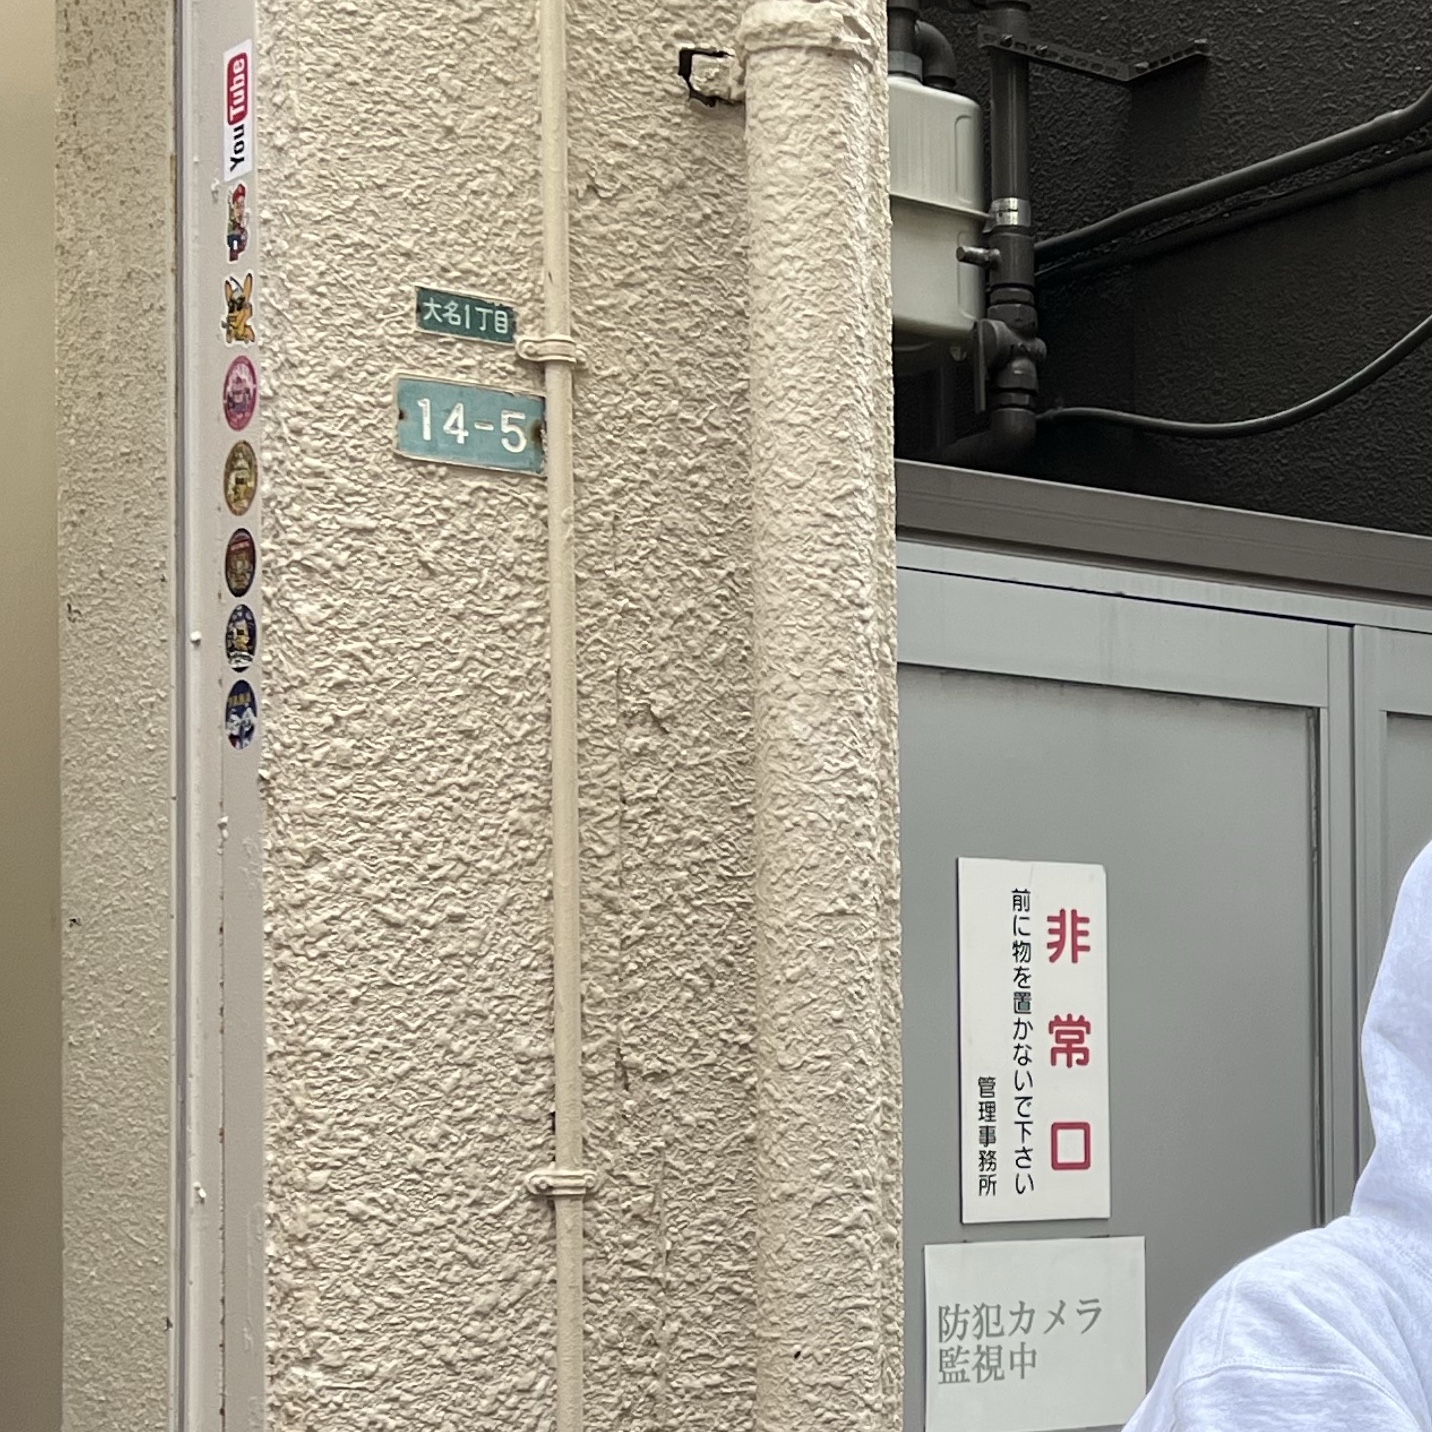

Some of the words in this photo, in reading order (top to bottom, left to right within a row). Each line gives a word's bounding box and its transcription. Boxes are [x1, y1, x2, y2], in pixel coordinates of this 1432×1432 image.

[228, 57, 247, 173] YouTube
[417, 398, 527, 453] 14-5
[1011, 888, 1035, 1196] 前に物を置かないで下さい
[1047, 908, 1092, 1171] 非常口
[977, 1076, 998, 1197] 管理事務所
[937, 1342, 1039, 1385] 監視中
[938, 1297, 1104, 1343] 防犯カメラ
